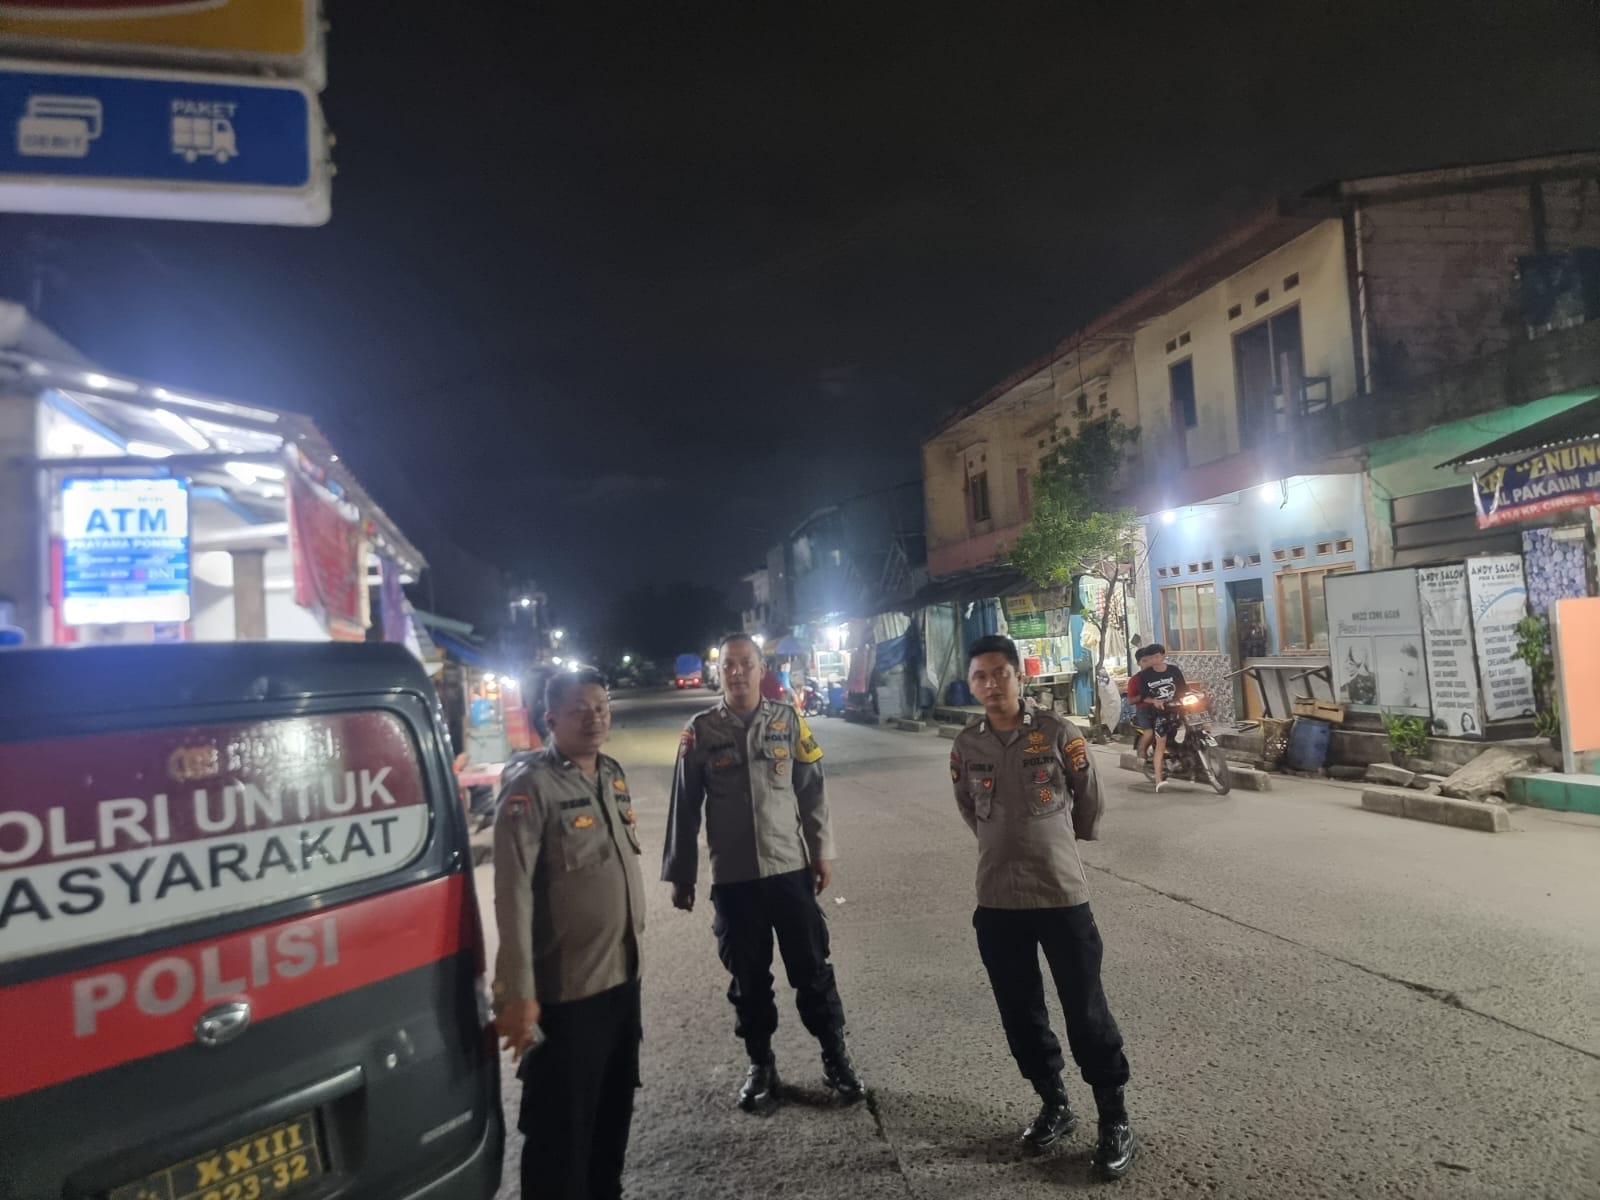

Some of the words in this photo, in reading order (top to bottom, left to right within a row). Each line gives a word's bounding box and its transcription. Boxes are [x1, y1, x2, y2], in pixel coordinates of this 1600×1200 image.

[172, 101, 237, 117] PAKET
[86, 508, 168, 533] ATM
[1471, 565, 1492, 576] ANDY
[1495, 561, 1520, 573] SALON
[1023, 756, 1054, 768] POLRI
[194, 766, 395, 833] UNTUK
[73, 917, 339, 1039] POLISI
[196, 1123, 303, 1187] XXIII
